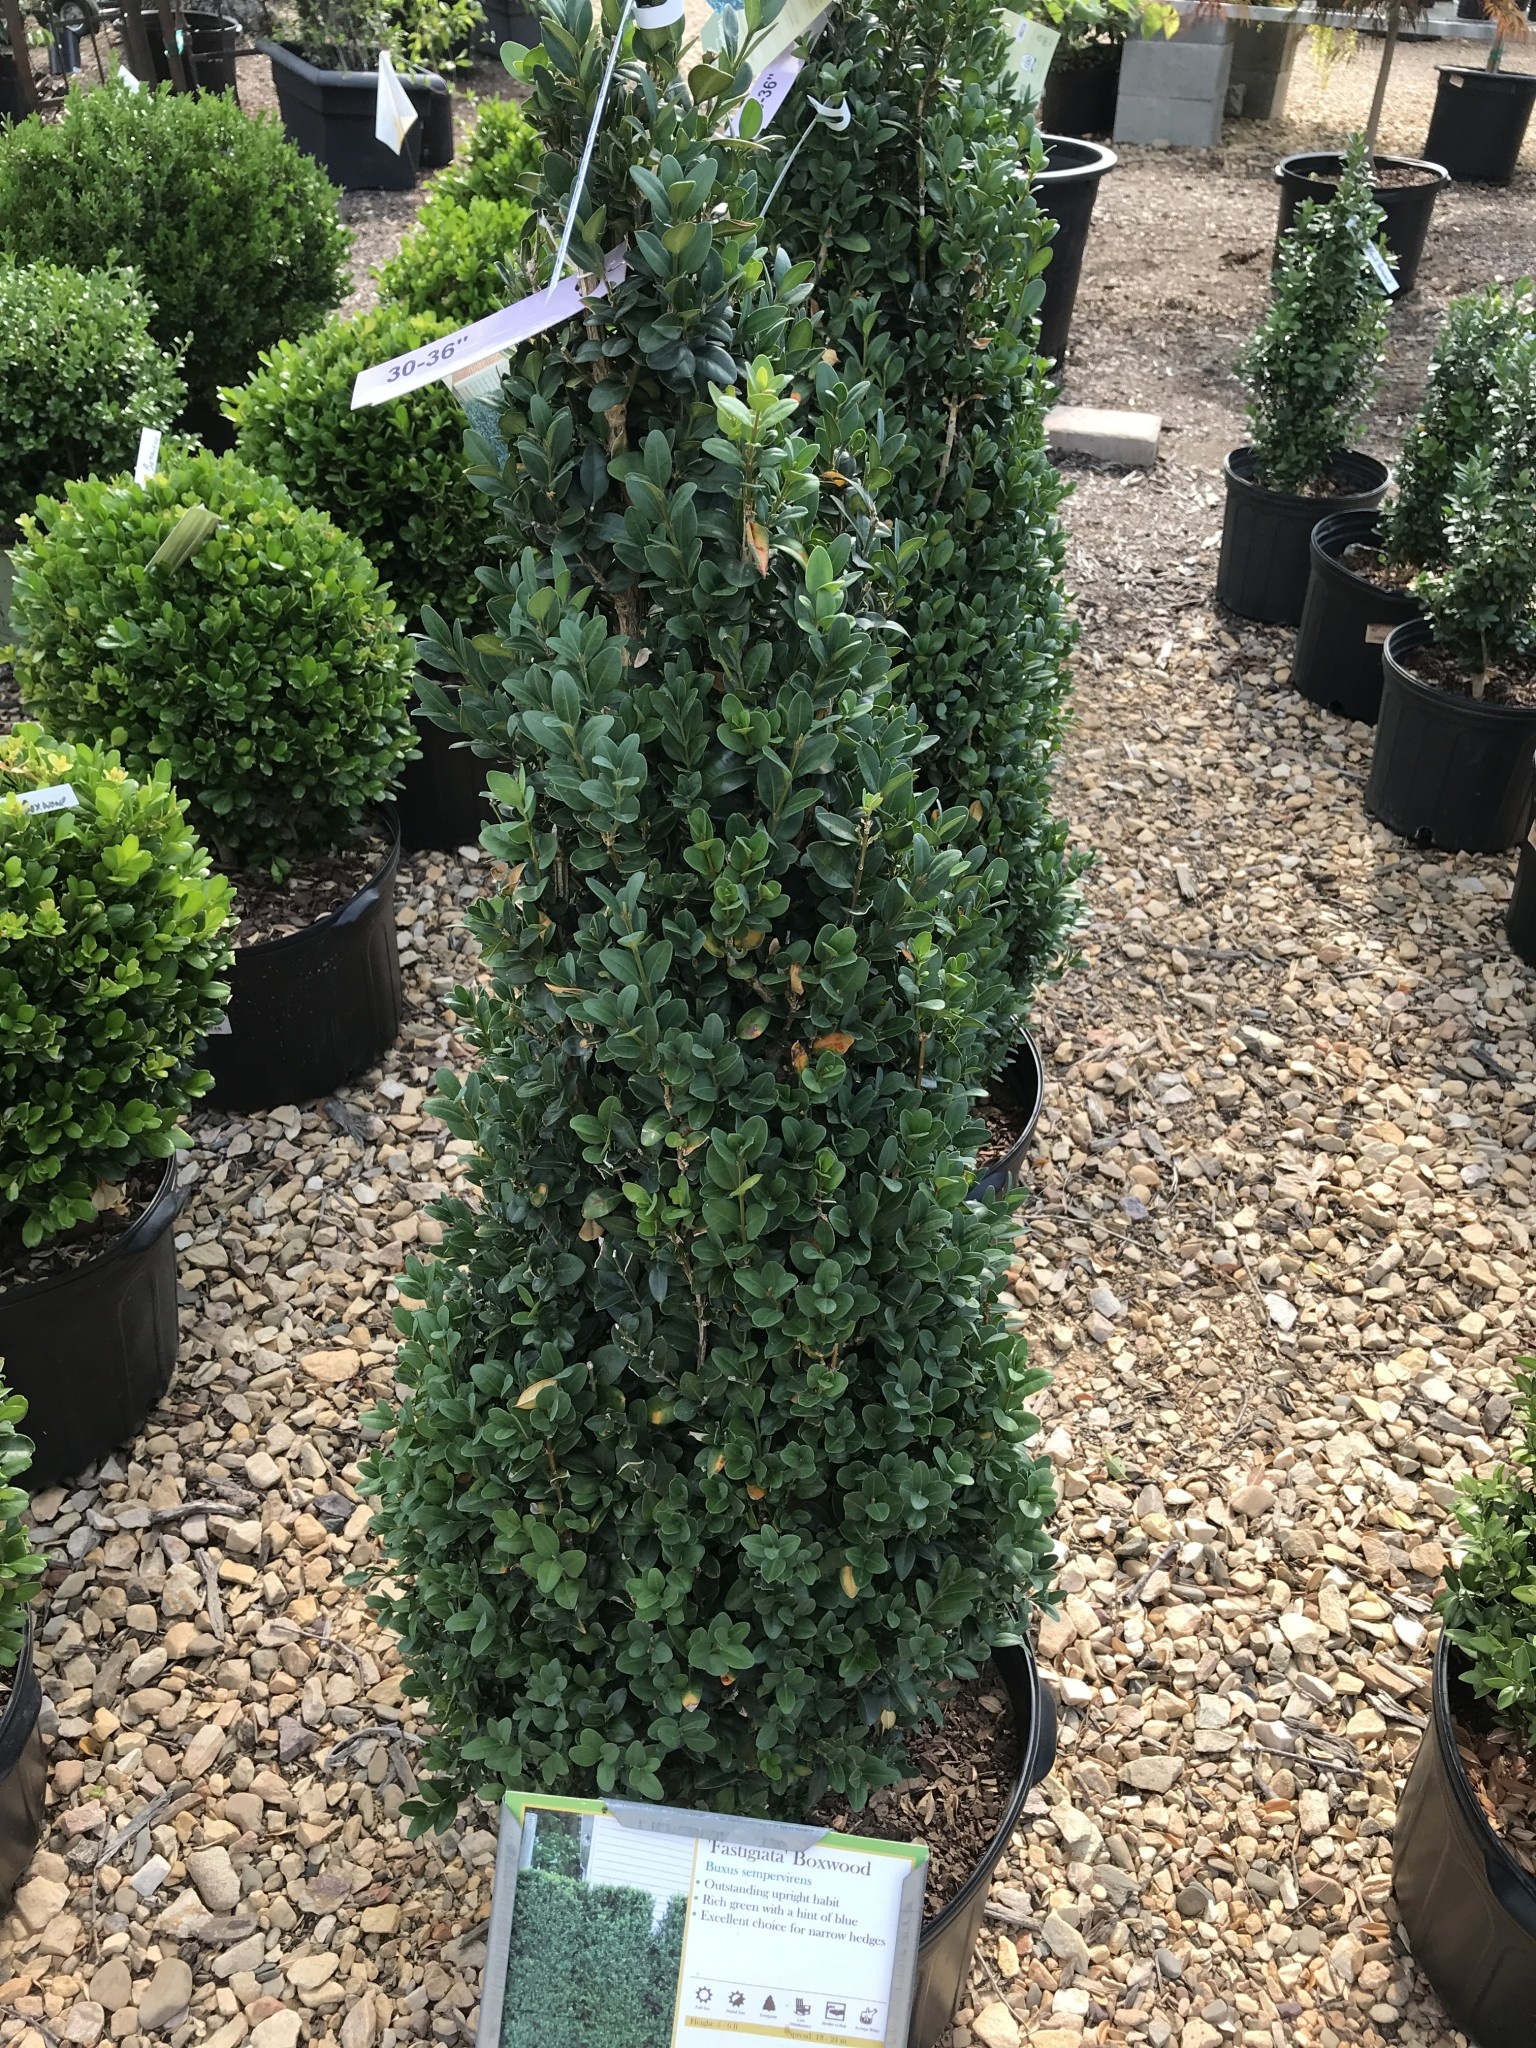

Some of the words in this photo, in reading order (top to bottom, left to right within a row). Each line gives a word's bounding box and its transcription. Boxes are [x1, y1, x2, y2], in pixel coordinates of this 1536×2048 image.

[386, 335, 469, 383] 30-36"
[705, 1860, 739, 1876] Buxus
[741, 1868, 812, 1887] sempervirens
[792, 1851, 871, 1877] Boxwood
[704, 1878, 769, 1900] Outstanding
[772, 1890, 810, 1904] upright
[813, 1893, 840, 1908] habit
[702, 1893, 727, 1908] Rich
[729, 1901, 759, 1912] green
[762, 1904, 785, 1916] with
[787, 1908, 793, 1917] a
[797, 1907, 818, 1921] hint
[820, 1912, 833, 1923] of
[834, 1913, 858, 1927] blue
[701, 1909, 750, 1927] Excellent
[752, 1917, 787, 1932] choice
[790, 1922, 806, 1935] for
[809, 1927, 847, 1941] narrow
[849, 1931, 886, 1947] hedges
